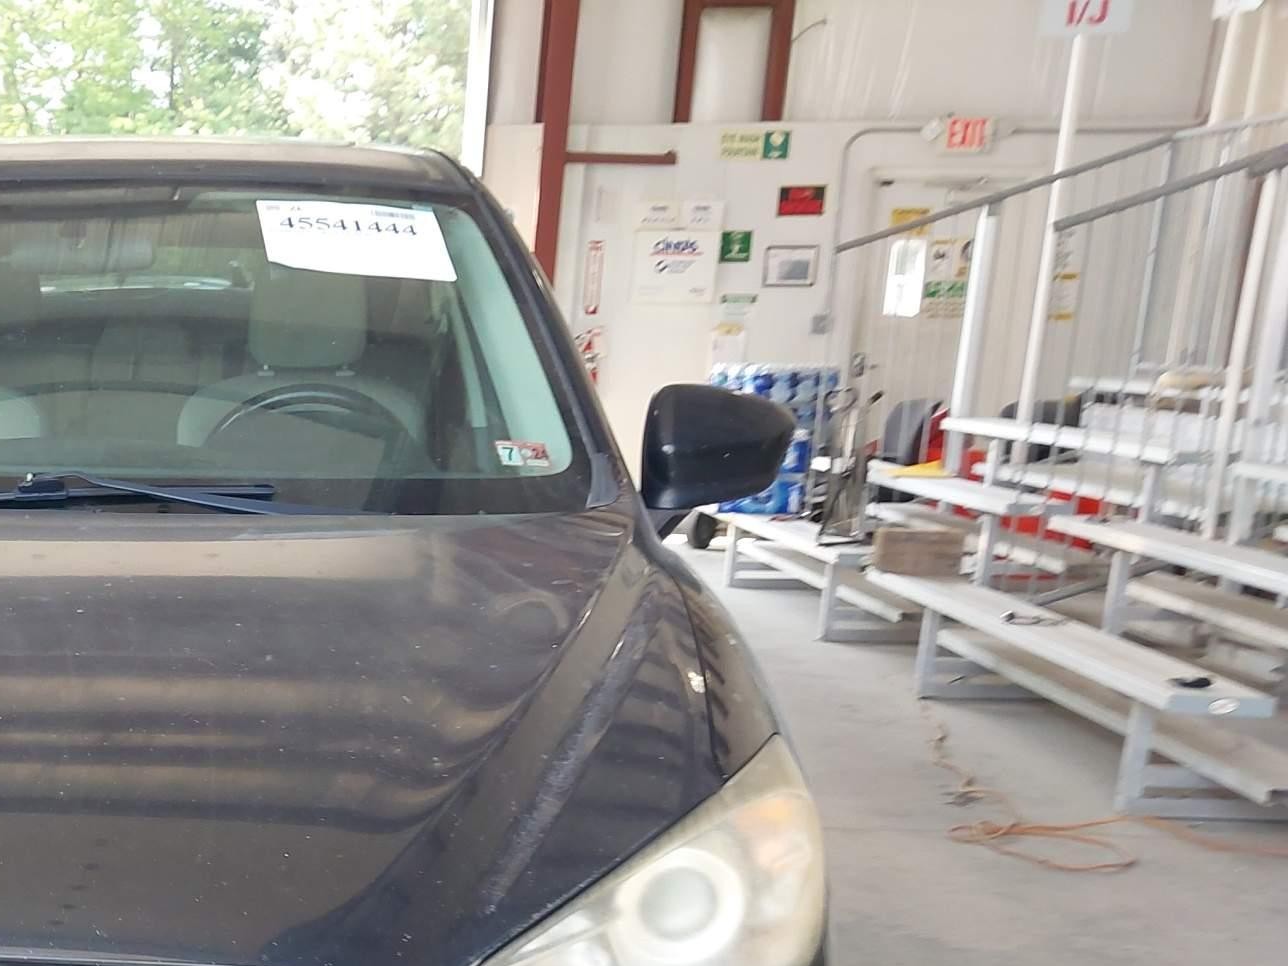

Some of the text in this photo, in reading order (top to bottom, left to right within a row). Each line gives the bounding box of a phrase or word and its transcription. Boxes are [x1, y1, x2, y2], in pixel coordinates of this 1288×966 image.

[946, 118, 986, 148] EXIT
[279, 216, 417, 235] 45541444
[502, 447, 513, 461] 7
